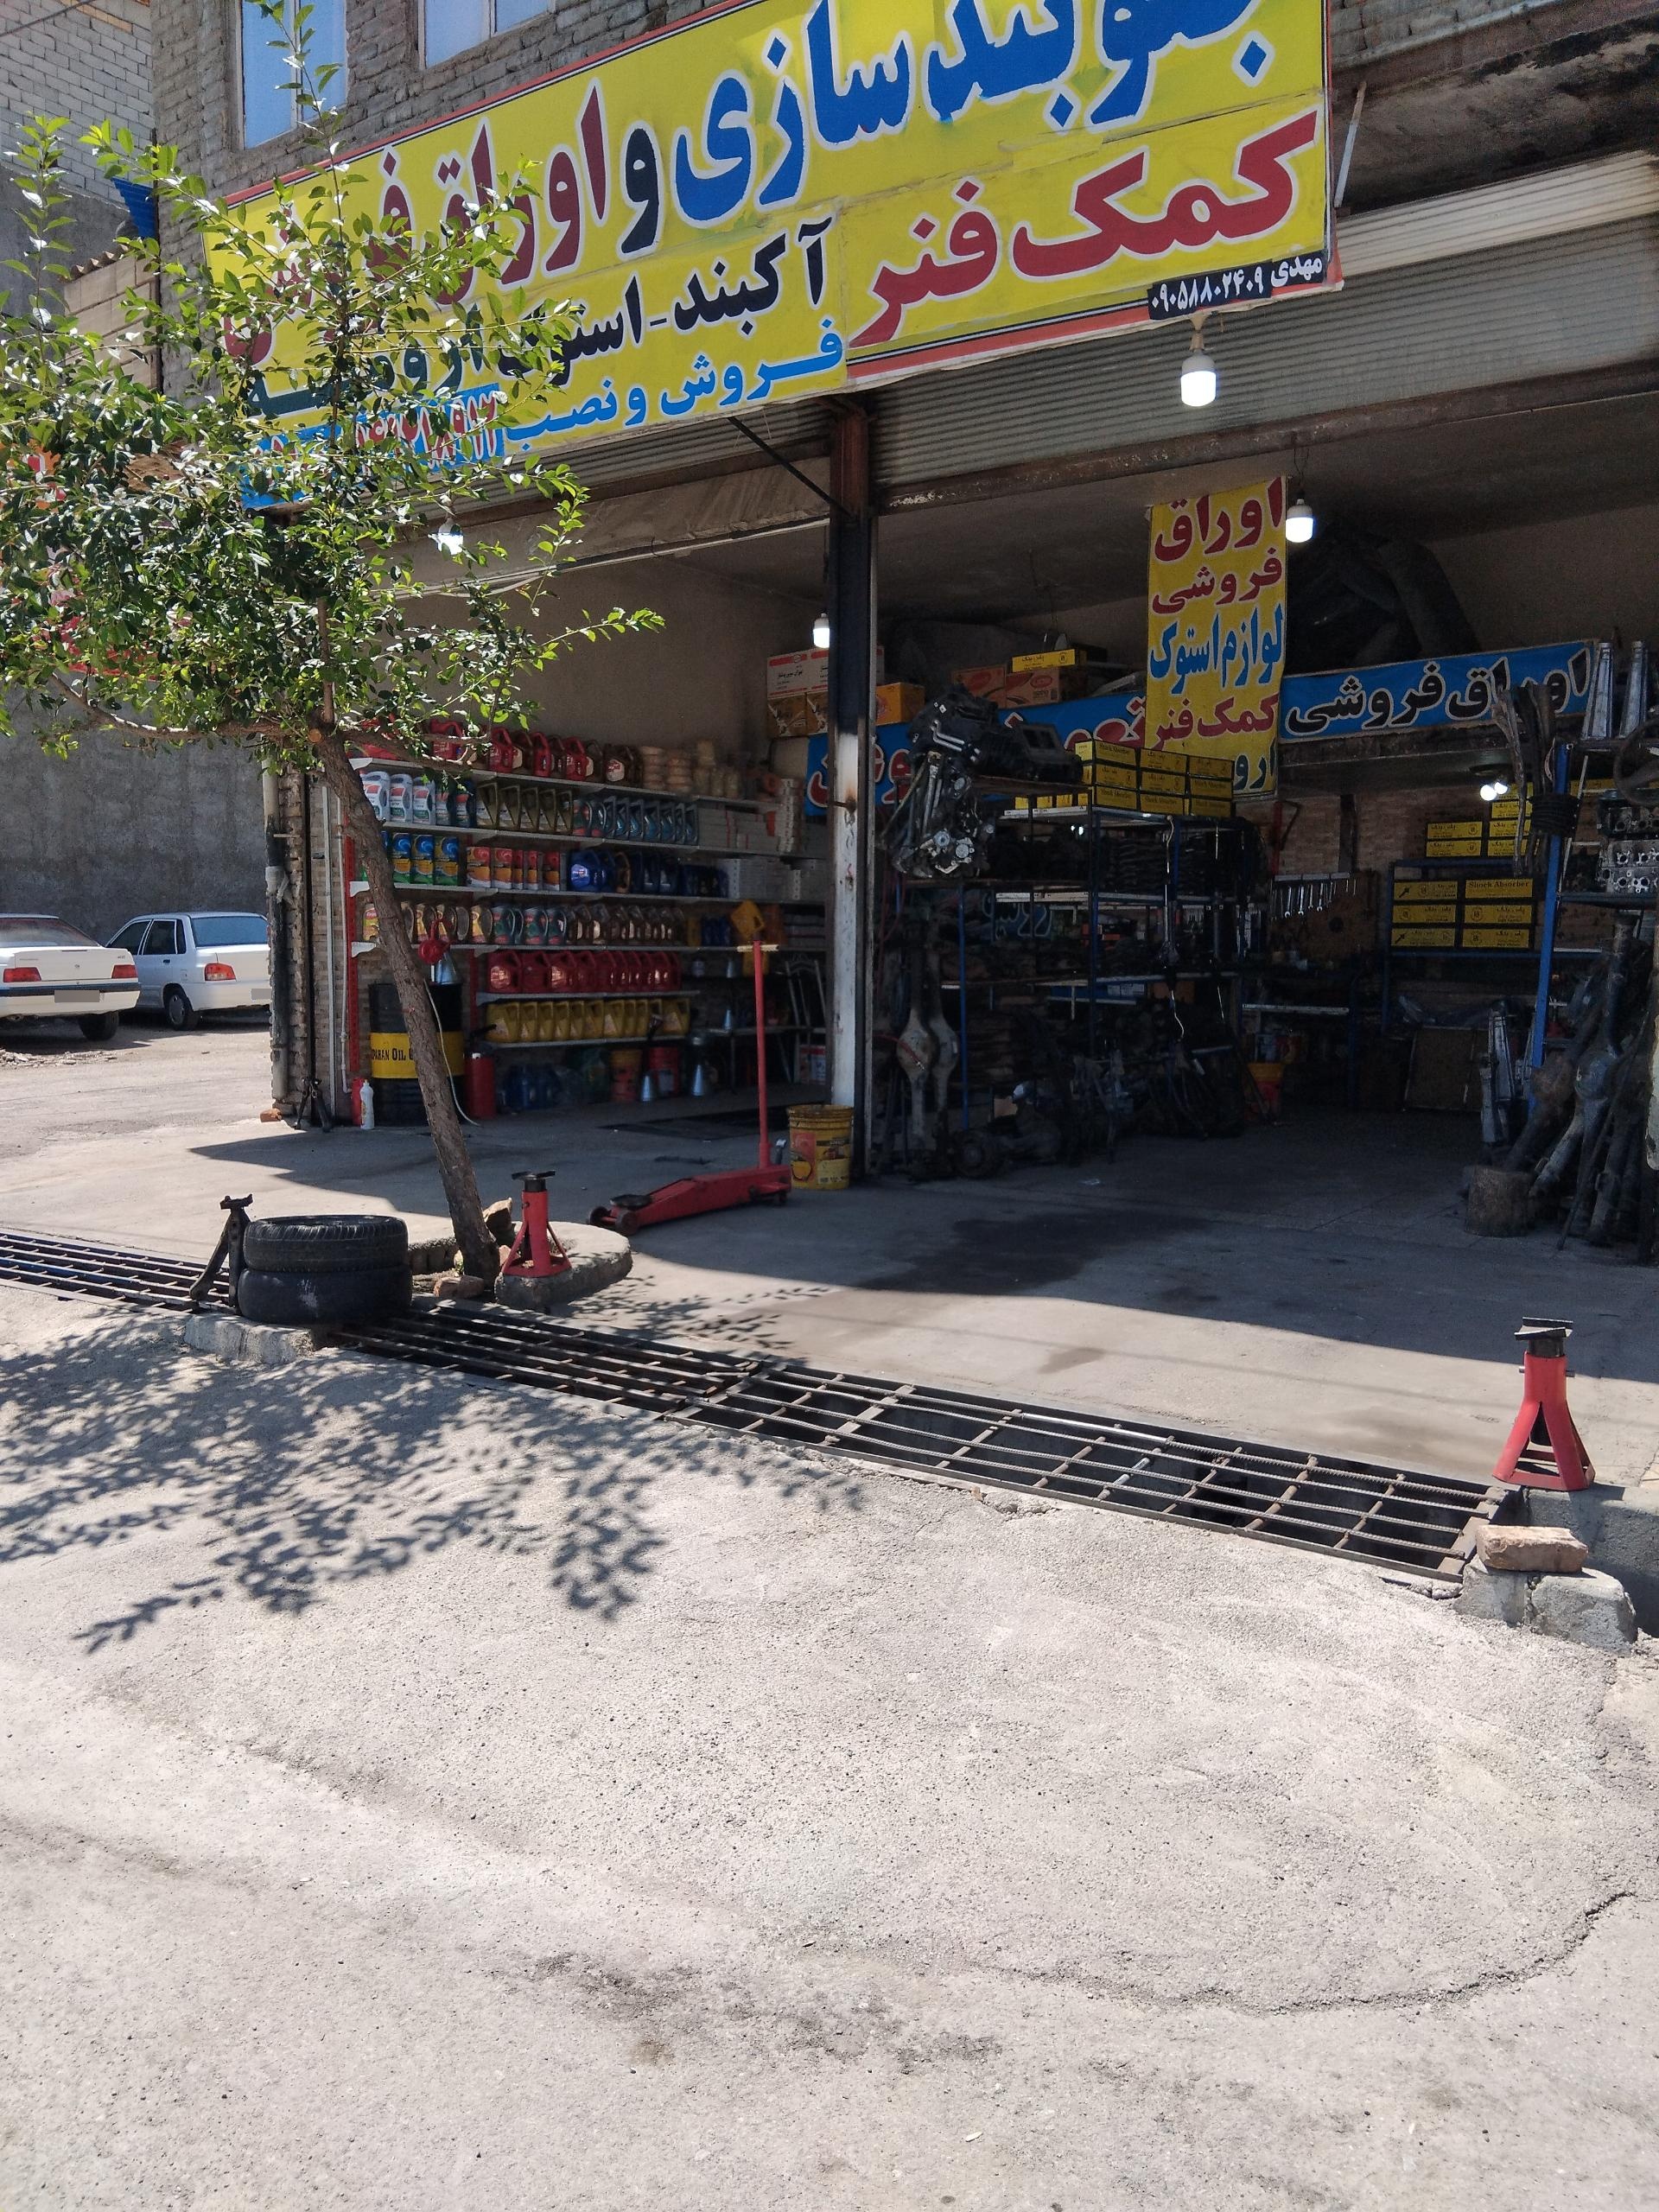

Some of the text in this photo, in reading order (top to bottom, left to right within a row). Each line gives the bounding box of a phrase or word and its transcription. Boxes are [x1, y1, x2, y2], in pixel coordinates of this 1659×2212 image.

[851, 111, 1318, 347] کمک فنر
[1152, 256, 1322, 312] مهدی ۰۹۰۵۸۸۰۲۴۰۹
[661, 320, 843, 416] فروش
[505, 379, 618, 452] نصب
[623, 387, 646, 426] و
[1154, 477, 1283, 563] اوراق
[1152, 547, 1282, 614] فروشی
[1150, 603, 1283, 695] لوازم استوک
[1150, 698, 1194, 750] فنر
[1198, 693, 1280, 734] کمک
[1286, 661, 1446, 734] فروشی
